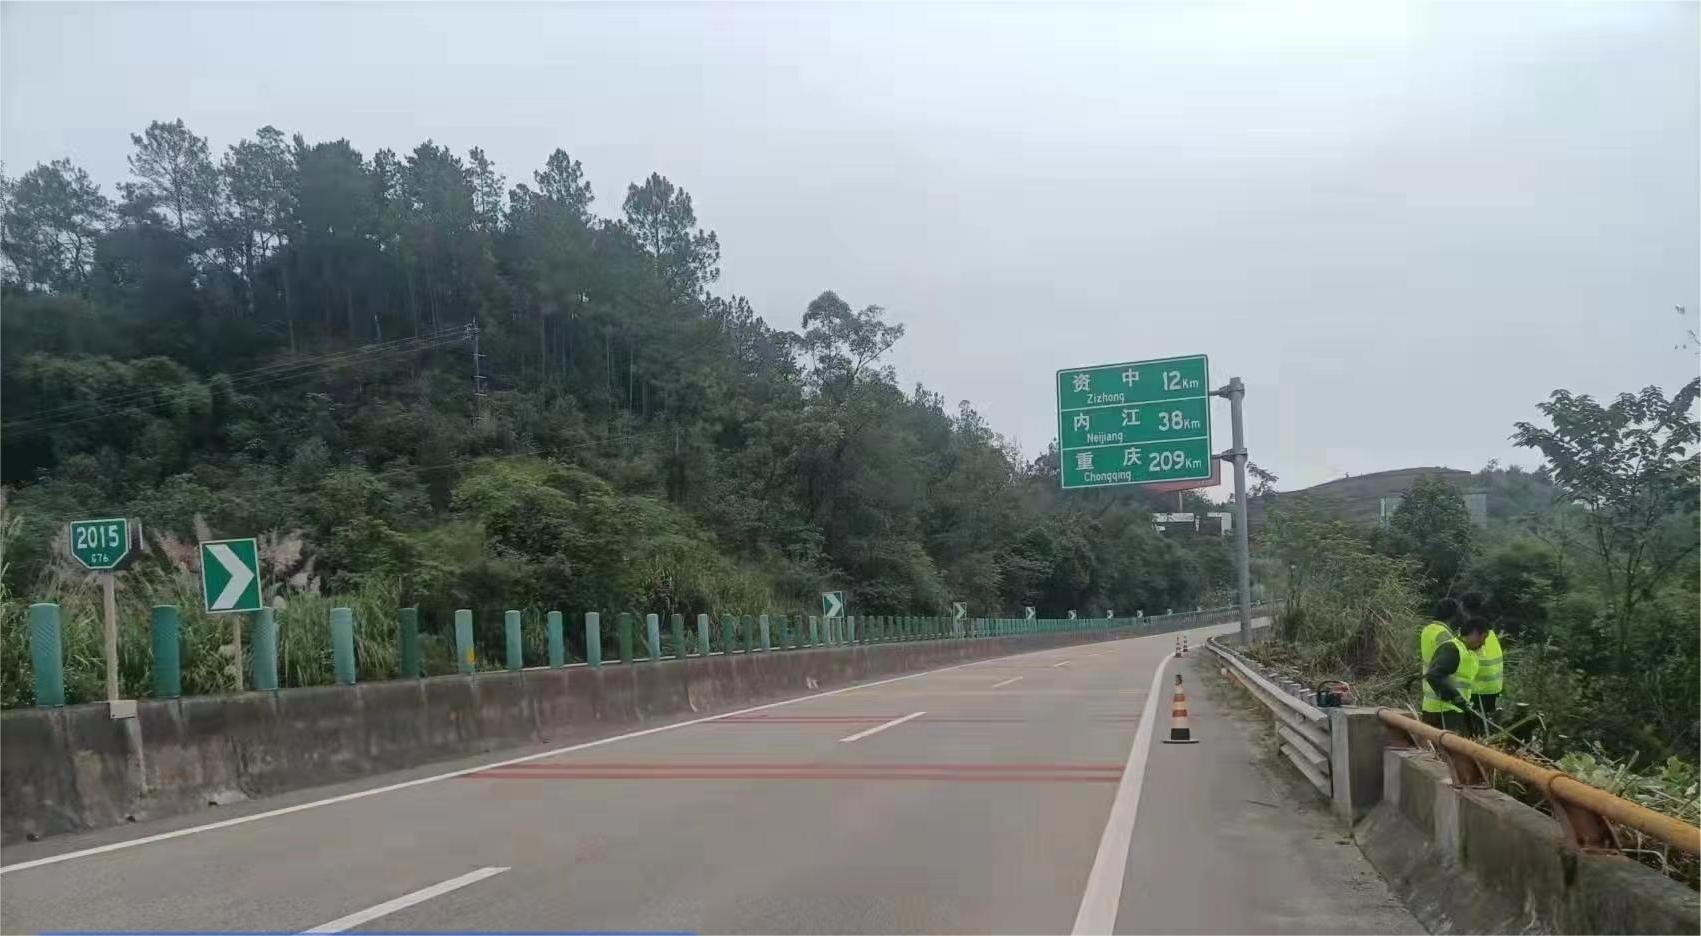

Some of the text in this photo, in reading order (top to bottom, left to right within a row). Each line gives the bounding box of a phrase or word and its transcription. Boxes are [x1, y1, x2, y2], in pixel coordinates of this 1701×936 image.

[1072, 368, 1139, 392] 资中
[1087, 392, 1125, 404] Zizhong
[1074, 408, 1141, 431] 内江
[1087, 432, 1123, 444] Neijiang
[1075, 447, 1142, 470] 重庆
[1084, 470, 1132, 483] Chongqing
[76, 525, 119, 549] 2015
